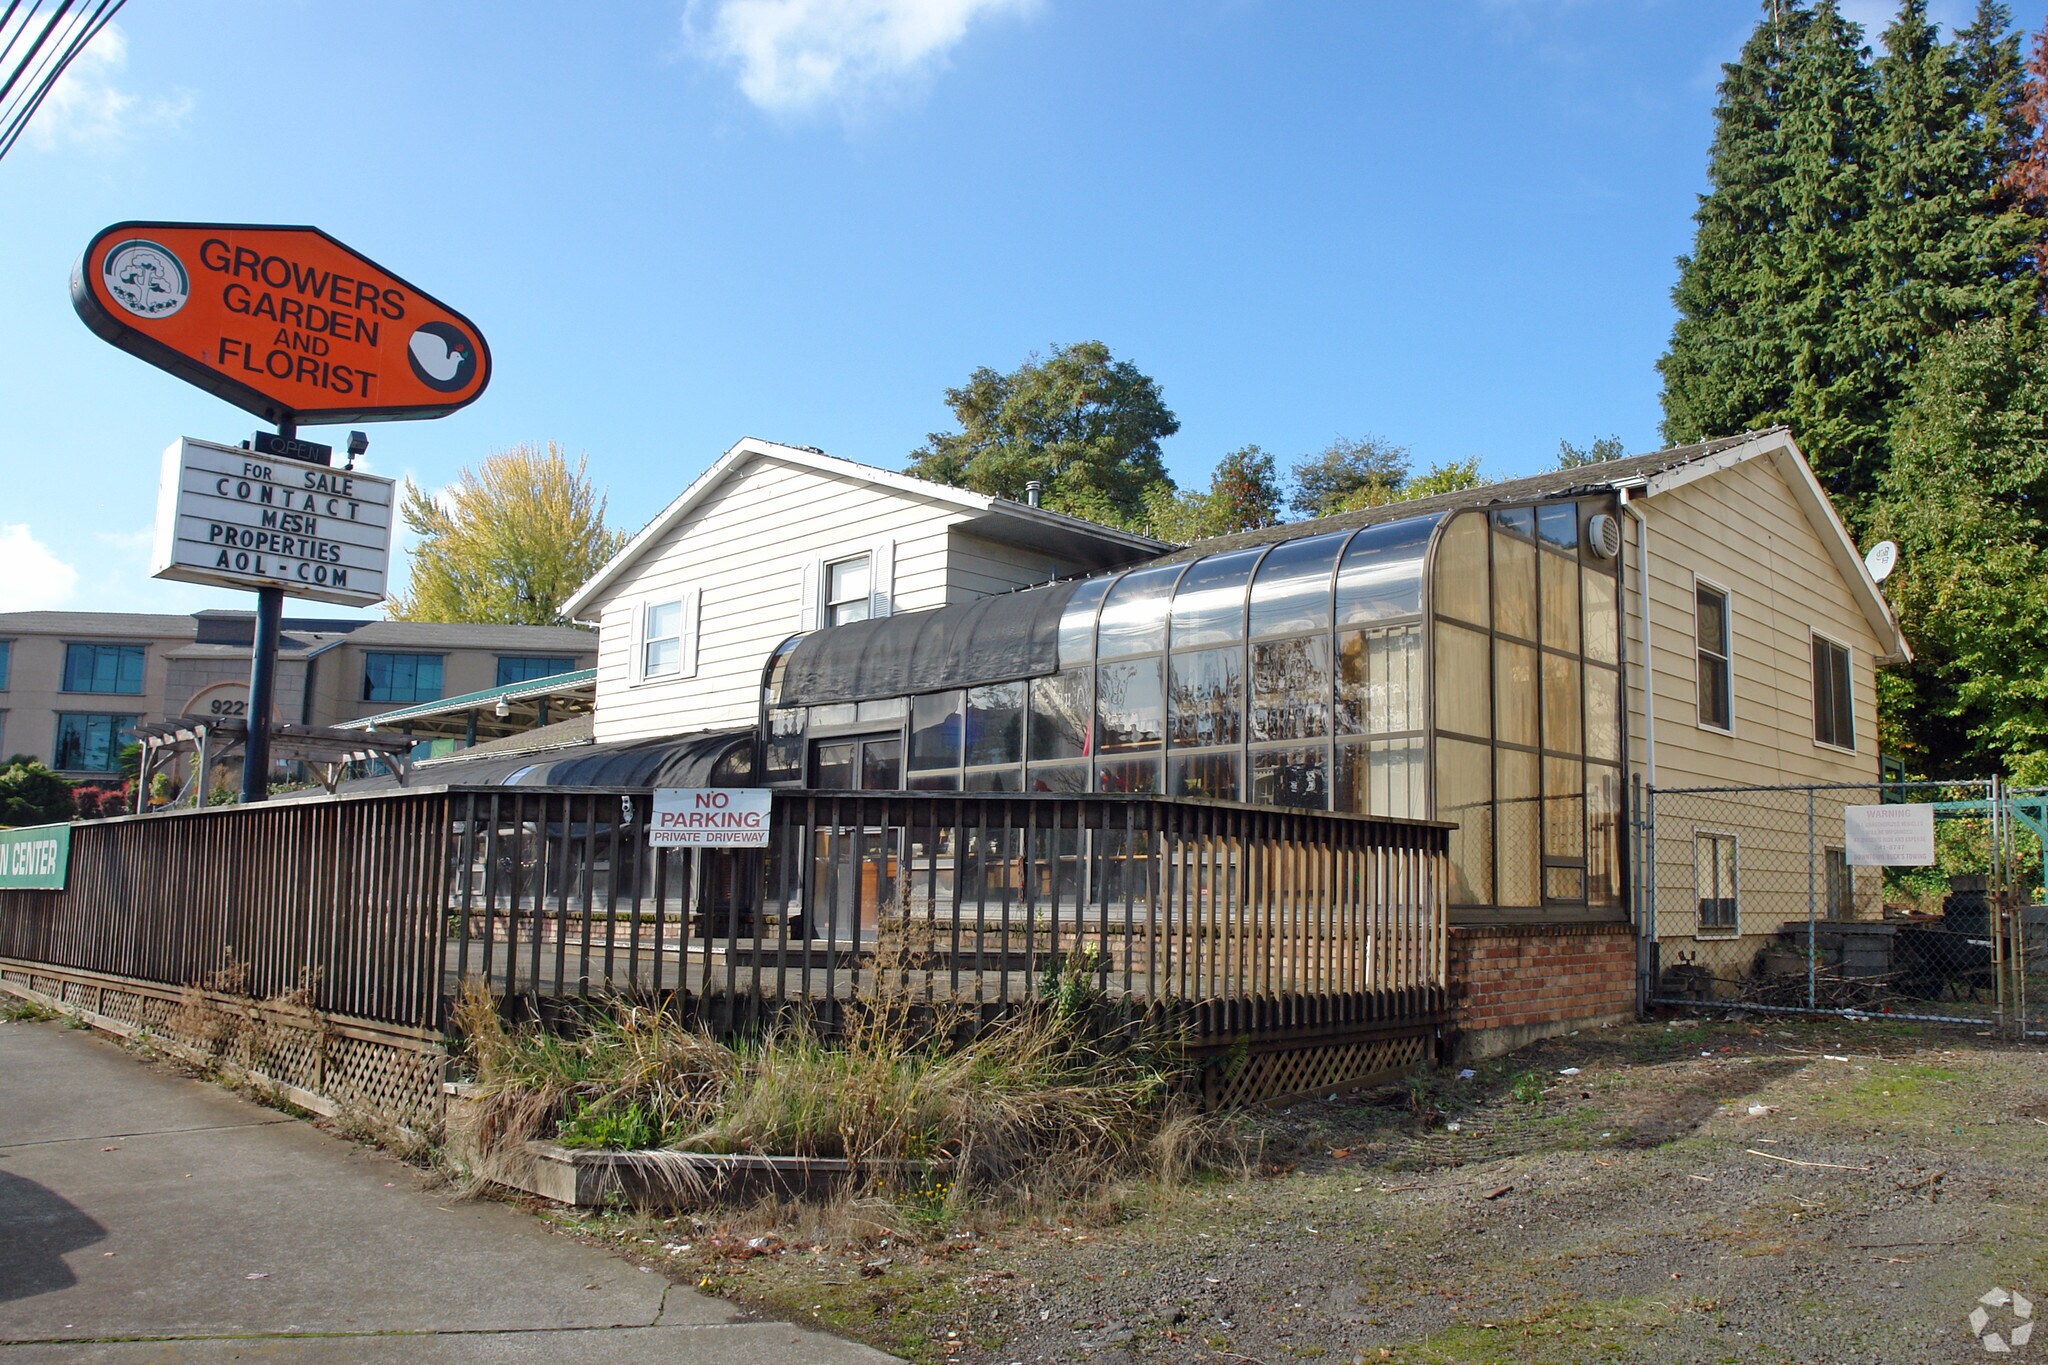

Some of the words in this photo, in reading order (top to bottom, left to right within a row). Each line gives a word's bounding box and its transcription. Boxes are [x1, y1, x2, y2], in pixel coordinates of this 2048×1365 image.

[200, 239, 405, 320] GROWERS
[222, 283, 379, 347] GARDEN
[273, 328, 329, 357] AND
[218, 337, 377, 398] FLORIST
[270, 437, 319, 461] OPEN
[243, 462, 272, 481] FOR
[304, 472, 353, 496] SALE
[216, 478, 359, 520] CONTACT
[261, 510, 317, 536] MESH
[209, 524, 341, 562] PROPERTIES
[211, 699, 249, 716] 922
[695, 792, 729, 809] NO
[1867, 809, 1911, 817] WARNING
[660, 811, 761, 828] PARKING
[654, 832, 700, 842] PRIVATE
[706, 832, 765, 842] DRIVEWAY
[12, 839, 57, 876] CENTER
